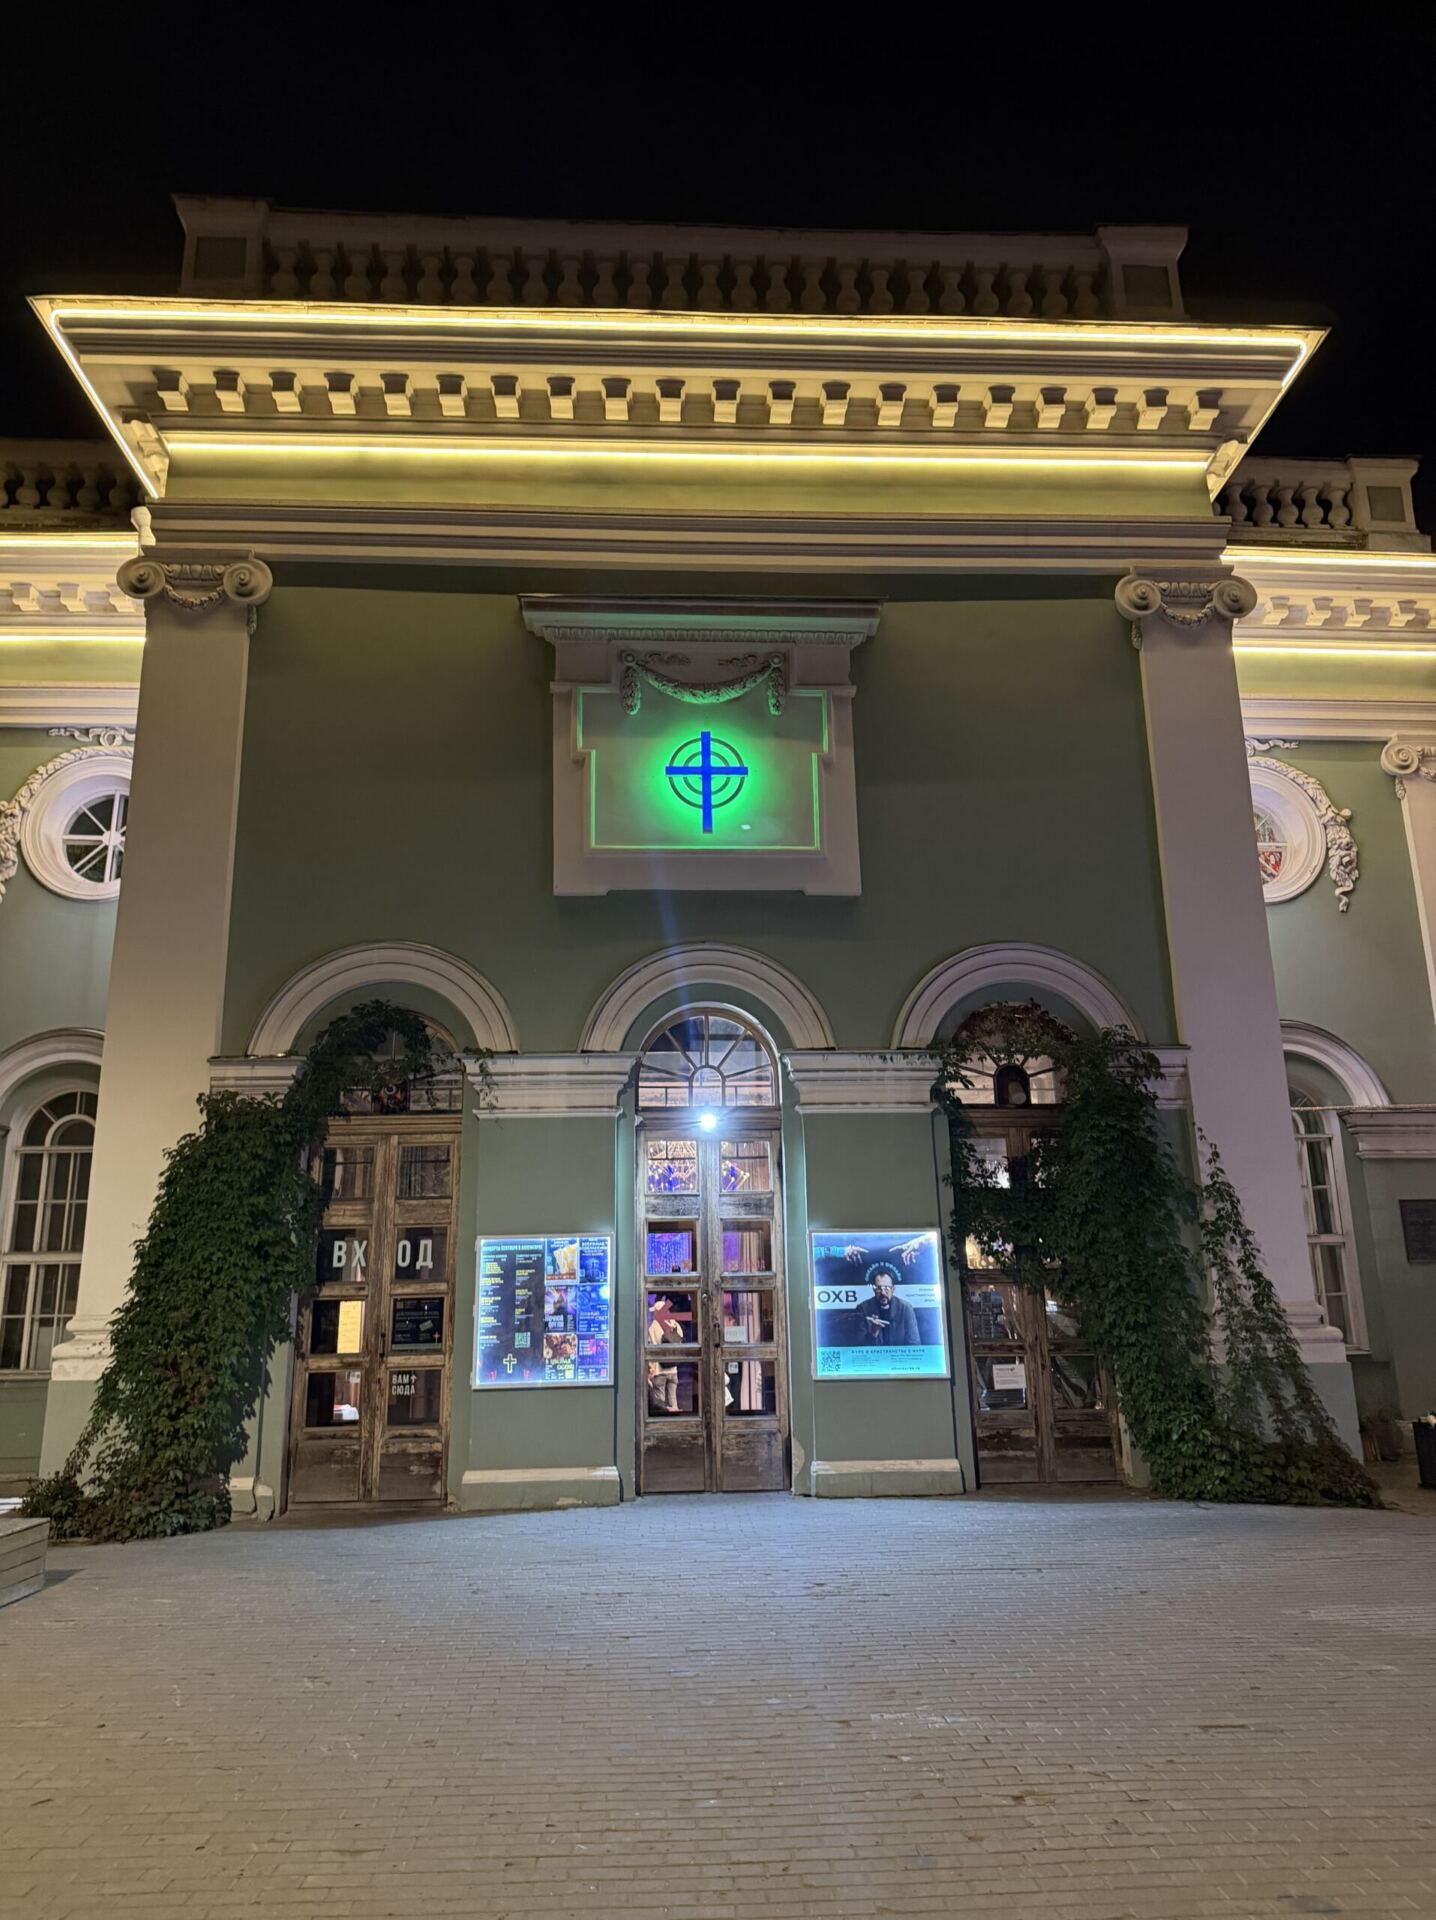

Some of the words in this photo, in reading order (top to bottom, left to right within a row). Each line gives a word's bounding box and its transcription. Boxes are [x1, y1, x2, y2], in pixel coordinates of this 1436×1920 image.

[332, 1239, 434, 1270] ВХОД
[392, 1374, 410, 1385] ВАМ
[391, 1385, 416, 1396] СЮДА
